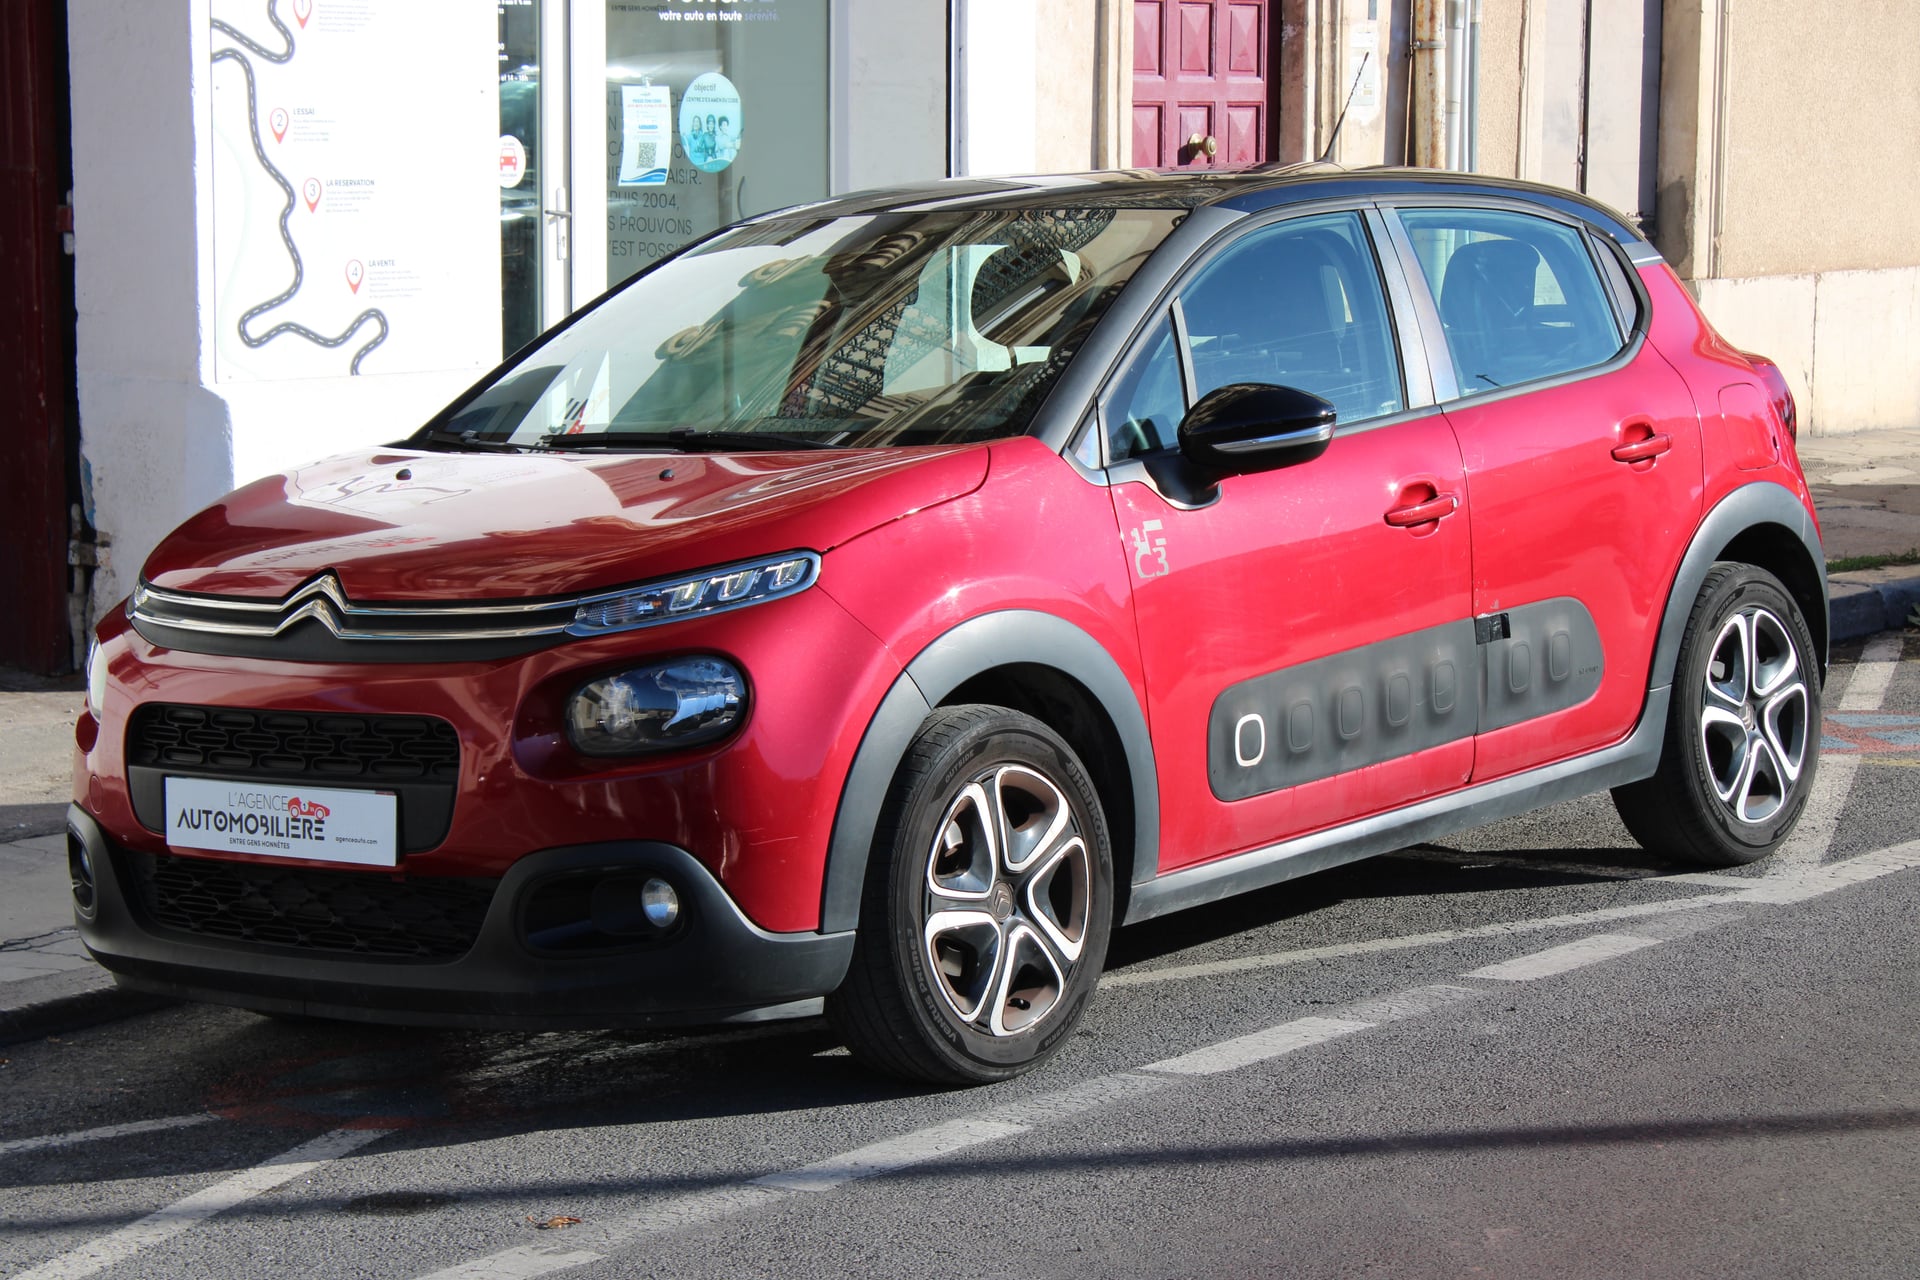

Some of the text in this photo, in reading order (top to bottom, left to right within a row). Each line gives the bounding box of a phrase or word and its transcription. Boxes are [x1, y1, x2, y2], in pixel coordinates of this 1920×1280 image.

[659, 10, 682, 21] votre
[684, 10, 705, 21] auto
[706, 12, 717, 21] en
[719, 10, 743, 21] toute
[694, 84, 717, 93] objectif
[276, 113, 284, 127] 2
[326, 179, 335, 188] LA
[667, 168, 702, 186] AISIR.
[309, 183, 317, 198] 3
[643, 192, 680, 211] 2004,
[620, 215, 692, 235] PROUVONS
[368, 259, 396, 268] LA VENTE
[351, 266, 359, 278] 4
[1135, 546, 1169, 579] C3
[945, 749, 975, 784] OUTSIDE
[228, 791, 289, 812] L'AGENCE
[229, 837, 291, 850] ENTRE GENS HONNÊTES
[335, 835, 378, 845] agenceauto.com
